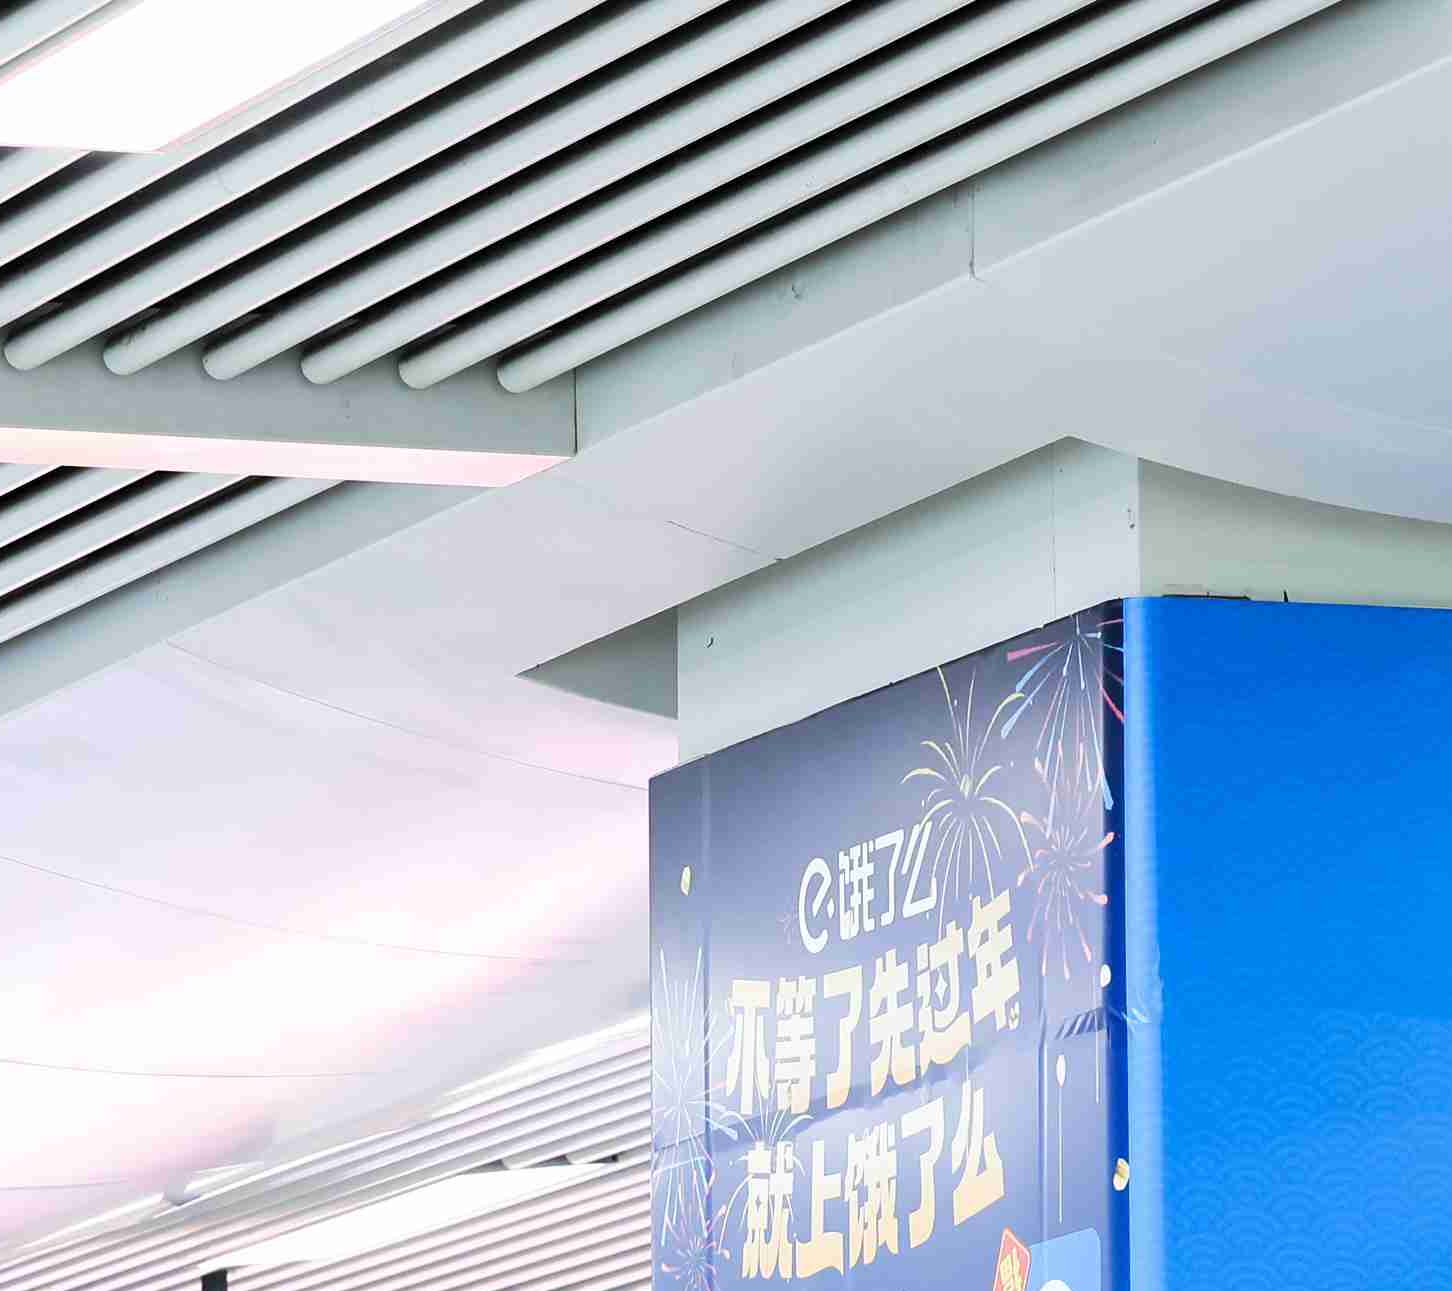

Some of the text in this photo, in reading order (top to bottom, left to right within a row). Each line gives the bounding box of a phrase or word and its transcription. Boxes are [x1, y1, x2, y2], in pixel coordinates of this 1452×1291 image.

[726, 887, 1022, 1115] 不等了先过年
[740, 1081, 1005, 1281] 就上饿了么
